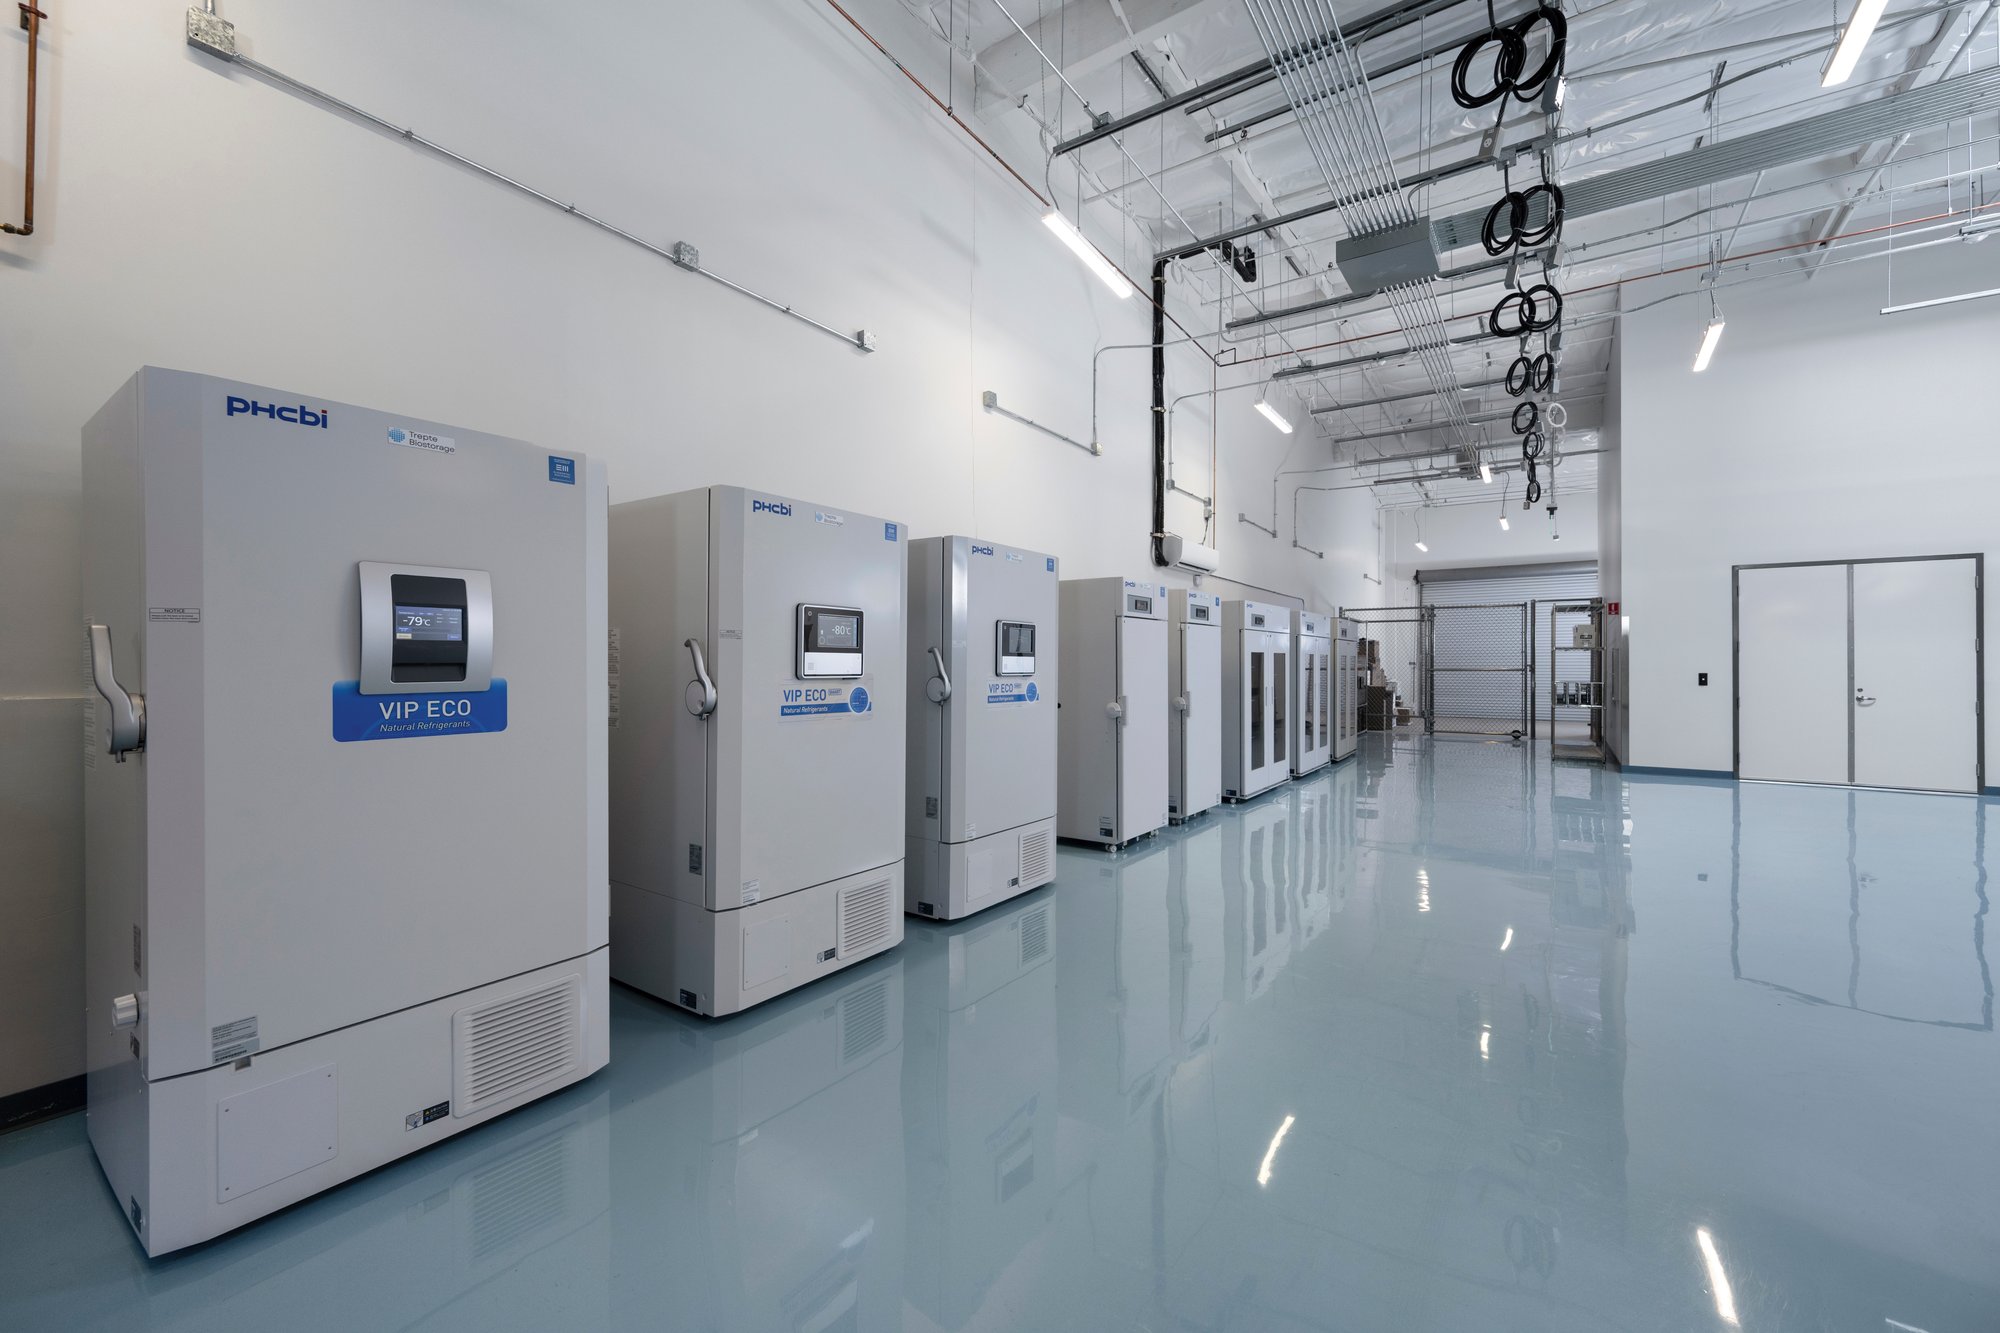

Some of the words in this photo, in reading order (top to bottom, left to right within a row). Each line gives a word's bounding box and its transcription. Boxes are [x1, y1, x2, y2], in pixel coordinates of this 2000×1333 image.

[409, 430, 438, 443] Trepte
[409, 438, 455, 454] Biostorage
[1000, 682, 1014, 693] ECO
[783, 689, 802, 703] VIP
[805, 688, 827, 702] ECO
[379, 702, 419, 720] VIP
[427, 699, 471, 718] ECO
[783, 706, 801, 714] Natural
[802, 705, 828, 714] Refrigerants
[380, 722, 415, 733] Natural
[418, 720, 471, 732] Refrigerants
